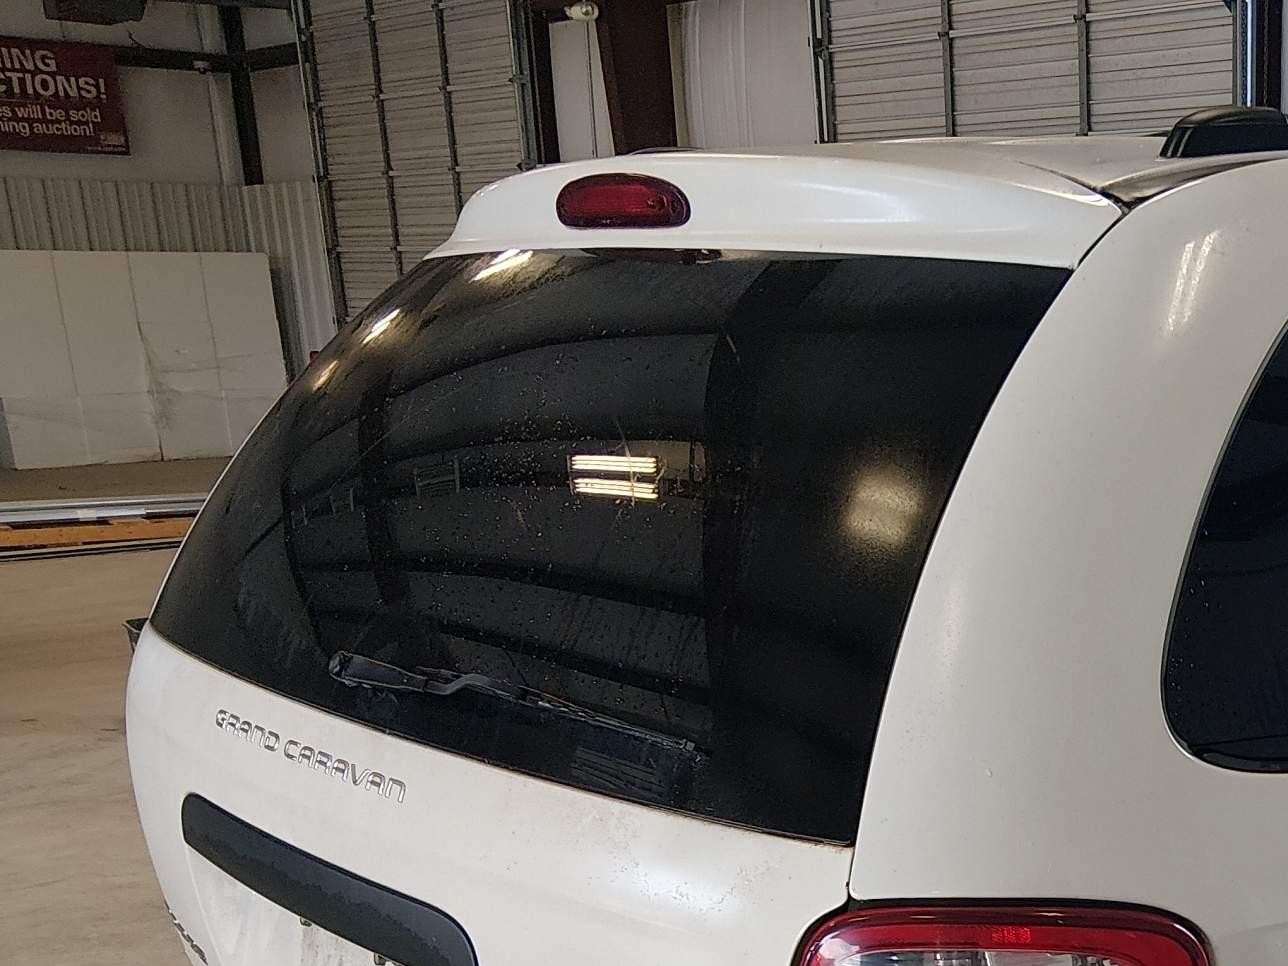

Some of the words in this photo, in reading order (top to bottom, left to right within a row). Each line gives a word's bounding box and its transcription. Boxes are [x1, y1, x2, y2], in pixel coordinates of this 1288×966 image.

[0, 47, 57, 72] ING
[14, 104, 43, 119] will
[45, 106, 66, 120] be
[69, 107, 101, 122] sold
[33, 122, 95, 137] auction!
[215, 709, 280, 752] GRAND
[284, 739, 407, 804] CARAVAN
